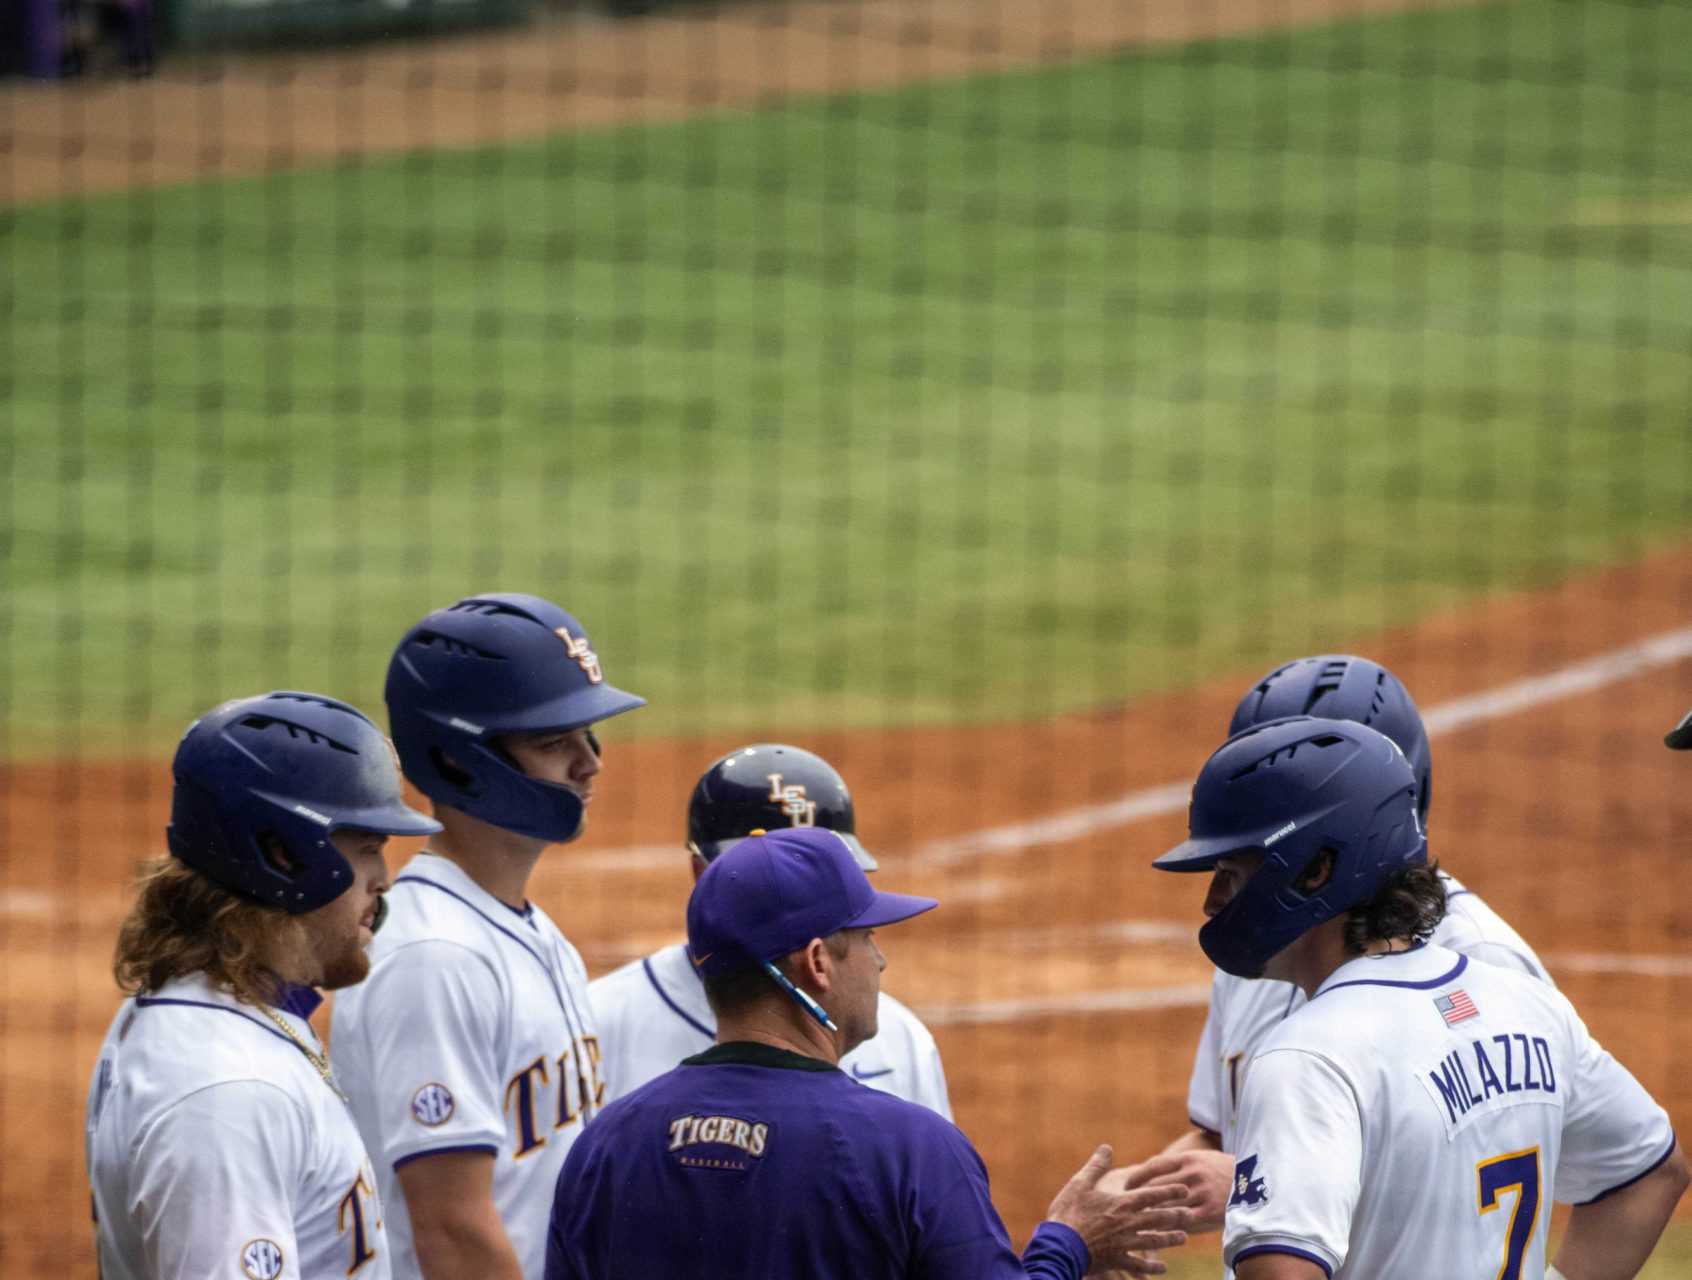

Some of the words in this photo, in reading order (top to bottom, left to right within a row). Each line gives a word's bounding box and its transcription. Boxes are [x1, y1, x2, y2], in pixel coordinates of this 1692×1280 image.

[554, 627, 603, 685] LSU
[767, 774, 816, 828] LSU
[413, 1083, 455, 1126] SEC
[1429, 1033, 1556, 1124] MILAZZO
[667, 1115, 769, 1156] TIGERS
